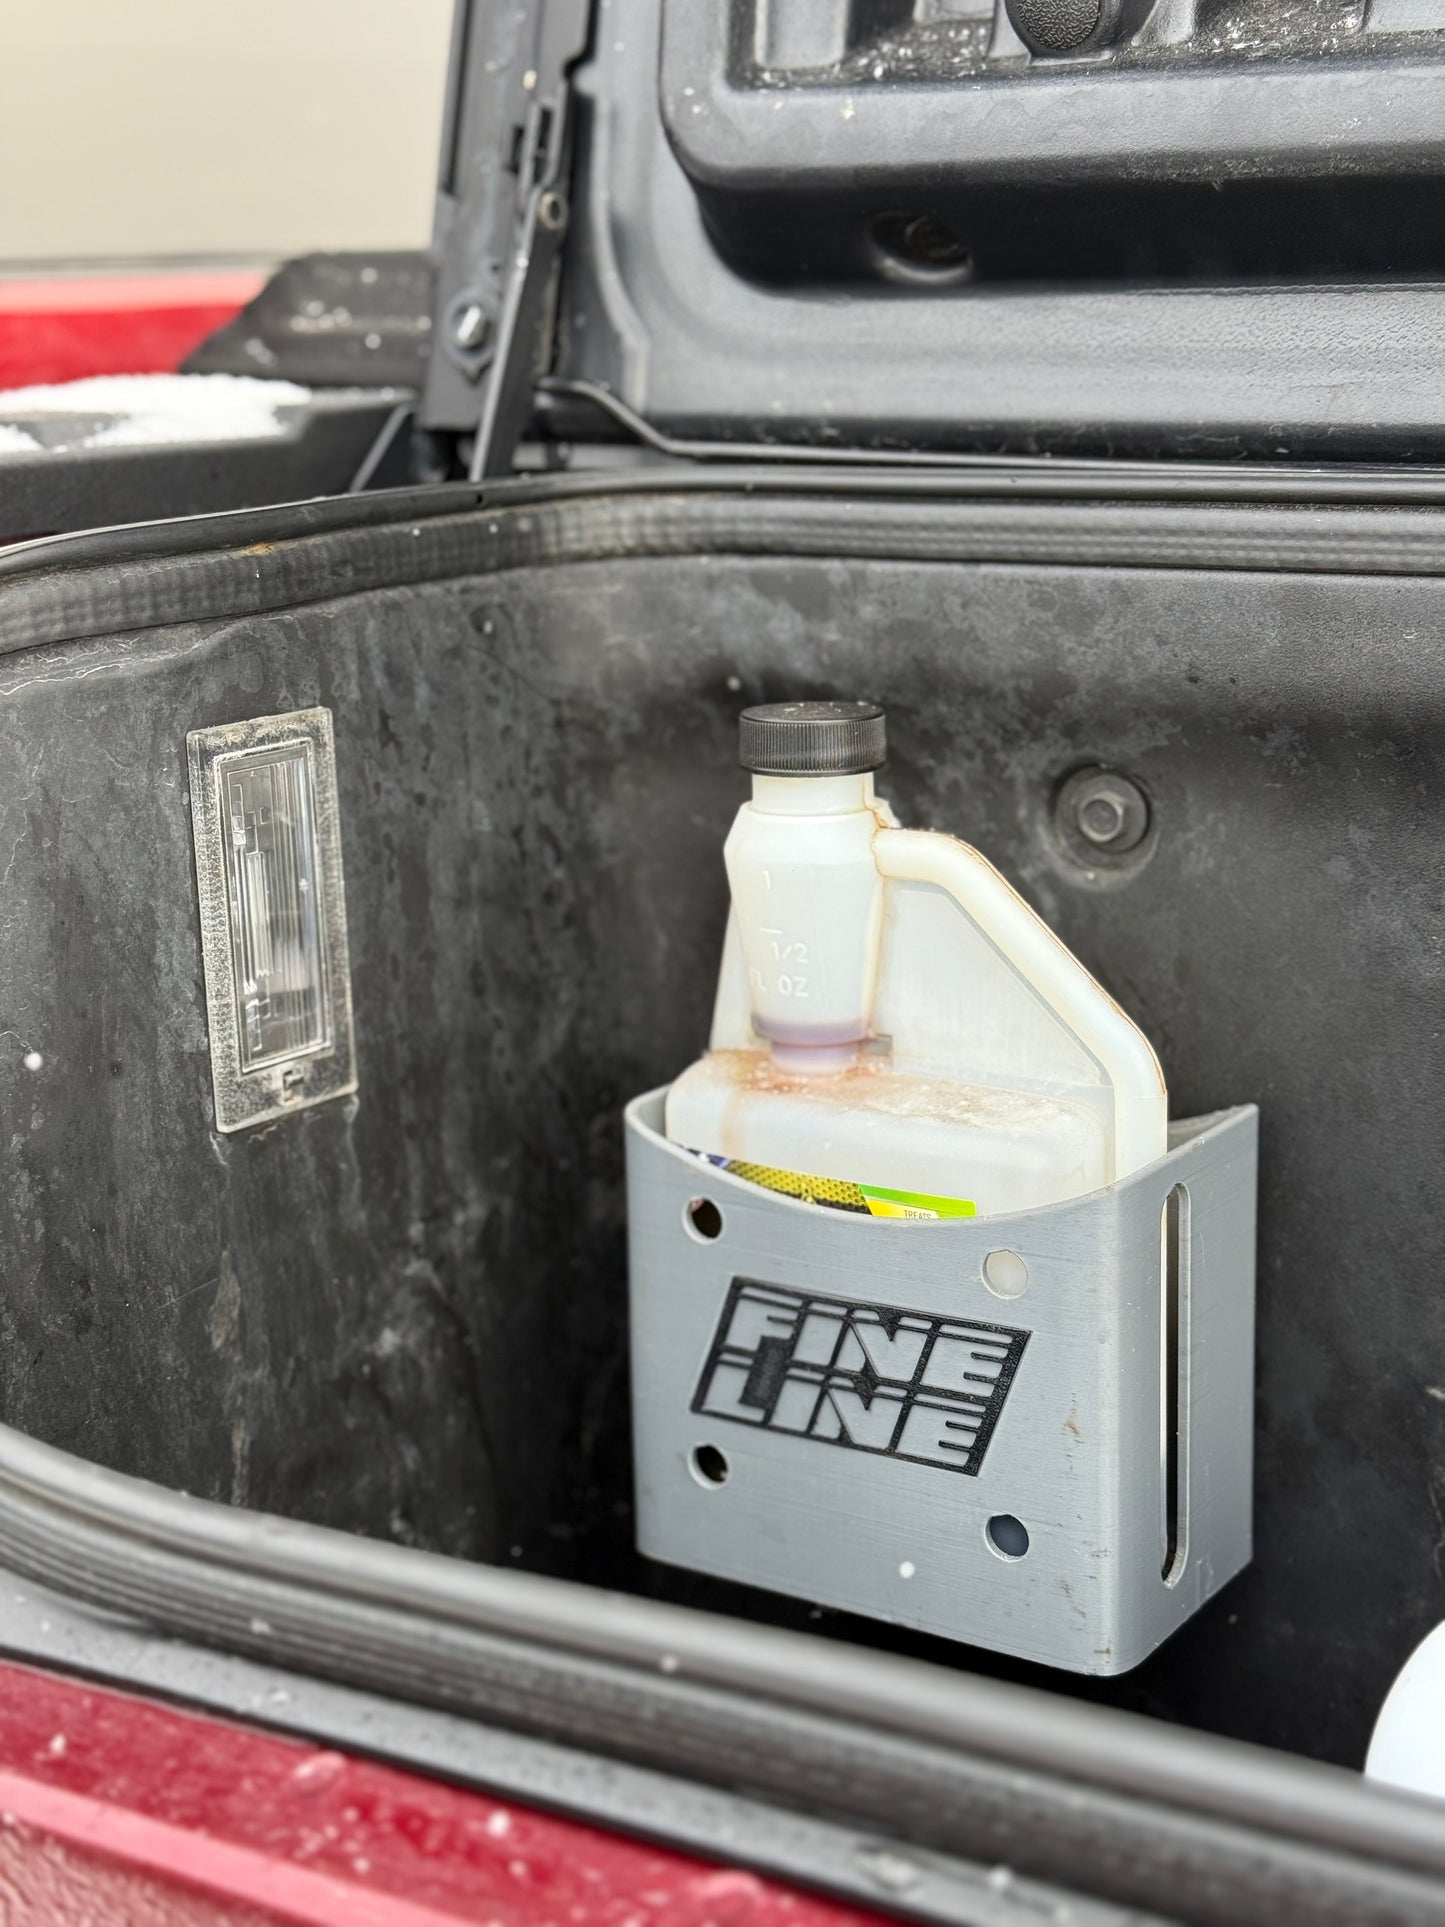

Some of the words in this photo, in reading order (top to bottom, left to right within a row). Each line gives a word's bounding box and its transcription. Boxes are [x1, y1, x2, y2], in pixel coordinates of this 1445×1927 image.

[771, 941, 809, 964] 1/2
[904, 1209, 932, 1219] TREATS
[722, 1284, 1014, 1400] FINE
[699, 1352, 989, 1469] LINE
